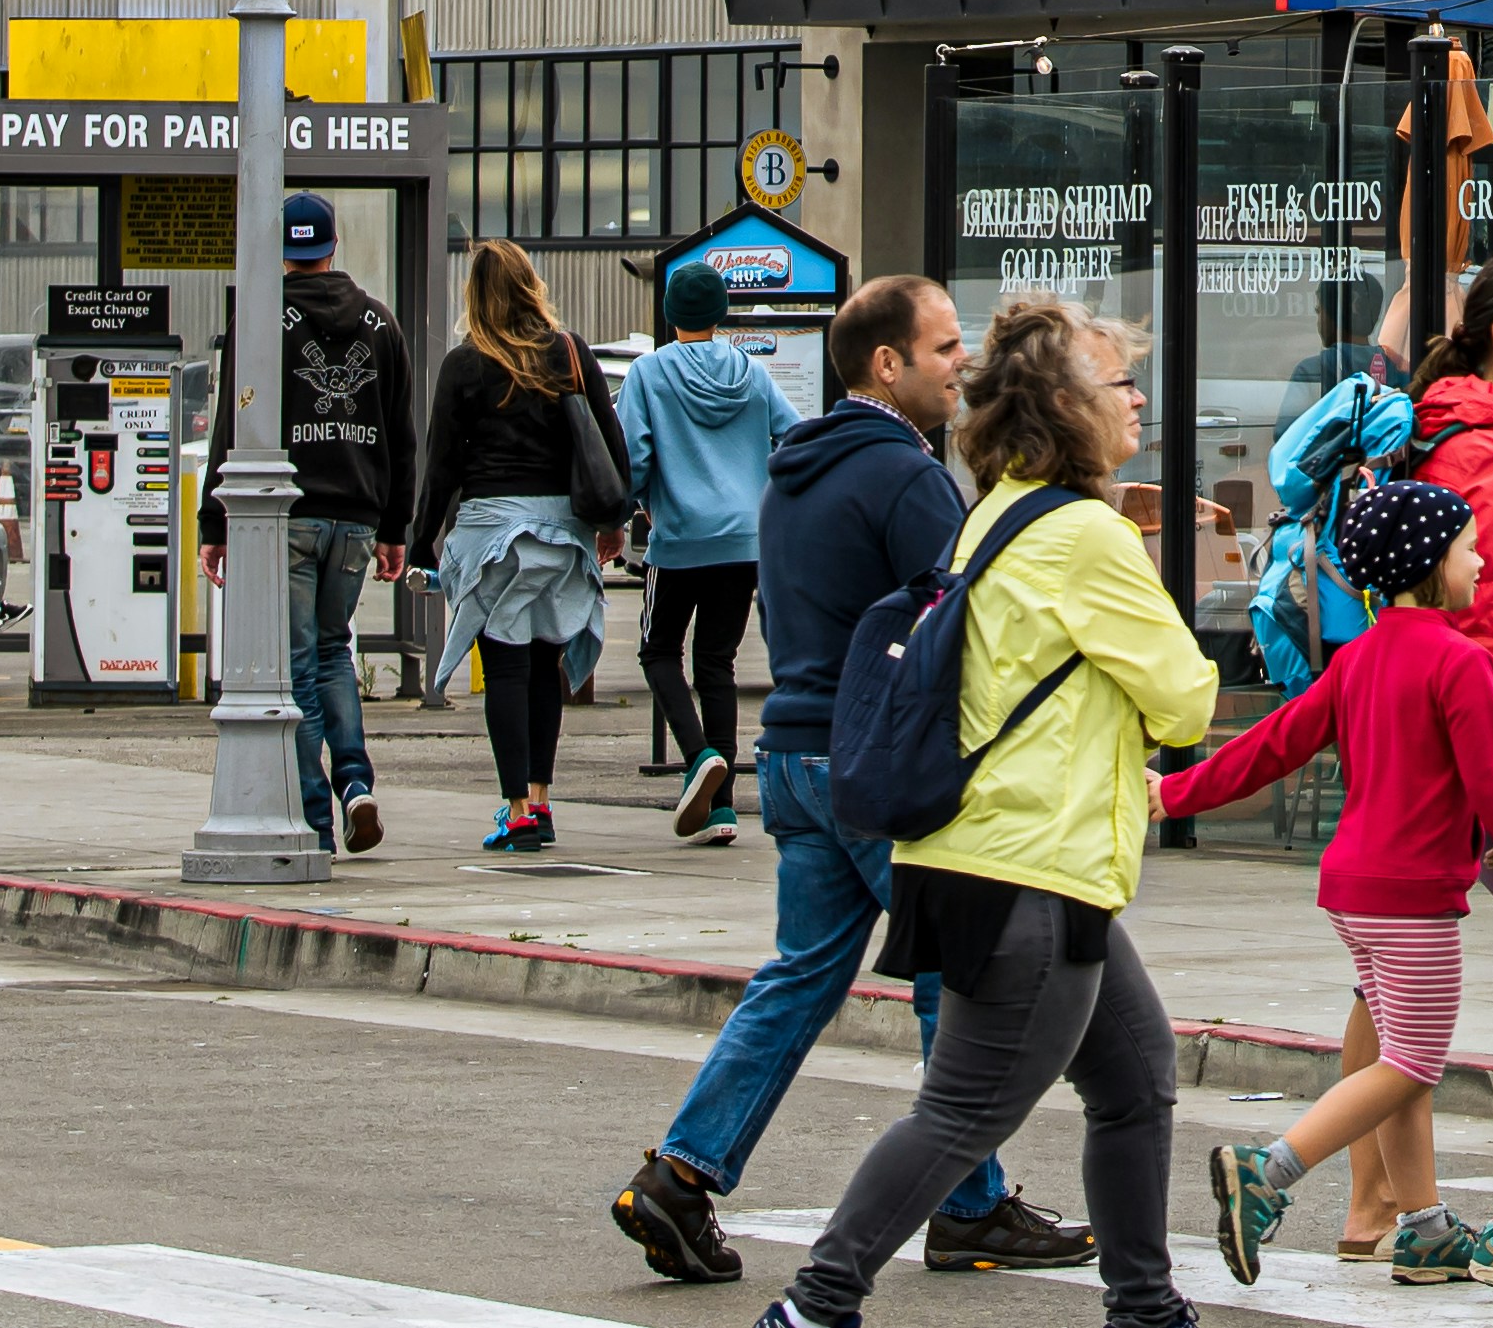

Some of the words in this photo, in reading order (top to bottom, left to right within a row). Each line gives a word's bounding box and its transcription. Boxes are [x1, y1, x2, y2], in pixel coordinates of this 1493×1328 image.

[2, 112, 69, 147] PAY
[84, 113, 148, 148] FOR
[328, 116, 409, 151] HERE
[745, 132, 772, 163] BISTRO
[775, 131, 803, 163] BOUDIN
[764, 152, 786, 185] B
[965, 187, 1059, 226] GRILLED
[1065, 184, 1153, 223] SHRIMP
[1226, 183, 1279, 223] FISH
[1285, 184, 1305, 222] &
[1310, 181, 1382, 222] CHIPS
[711, 251, 784, 274] Chowder
[1001, 247, 1058, 282] COLD
[1063, 246, 1114, 281] BEER
[1244, 247, 1304, 282] COLD
[1309, 246, 1364, 282] BEER
[732, 269, 765, 283] HUT
[65, 290, 102, 302] Credit
[105, 290, 134, 302] Card
[136, 291, 152, 302] Or
[68, 304, 101, 315] Exact
[104, 304, 150, 318] Change
[91, 318, 126, 329] ONLY
[118, 362, 138, 372] PAY
[140, 362, 169, 372] HERE
[119, 409, 157, 418] CREDIT
[125, 421, 154, 430] ONLY
[293, 422, 378, 444] BONEYARDS
[99, 659, 158, 671] DATAPARK
